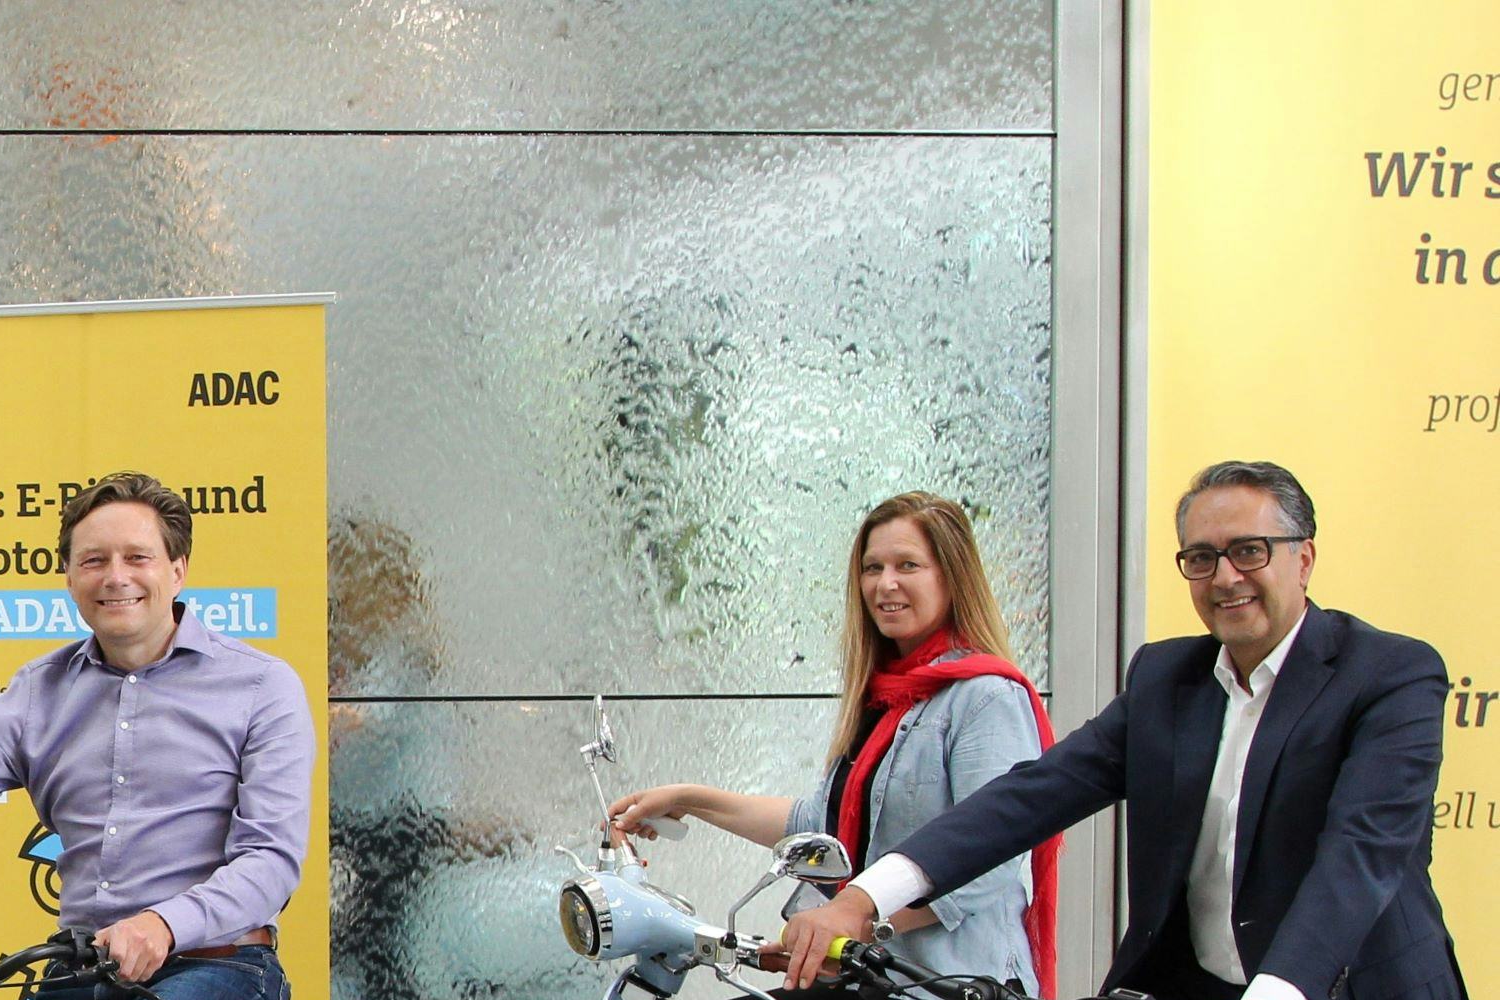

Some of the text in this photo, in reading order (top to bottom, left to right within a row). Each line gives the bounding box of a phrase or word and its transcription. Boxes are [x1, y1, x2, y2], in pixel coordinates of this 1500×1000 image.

[1363, 145, 1474, 198] Wir
[1414, 232, 1468, 285] in
[187, 370, 280, 407] ADAC
[181, 475, 268, 516] und
[1449, 676, 1500, 728] ir
